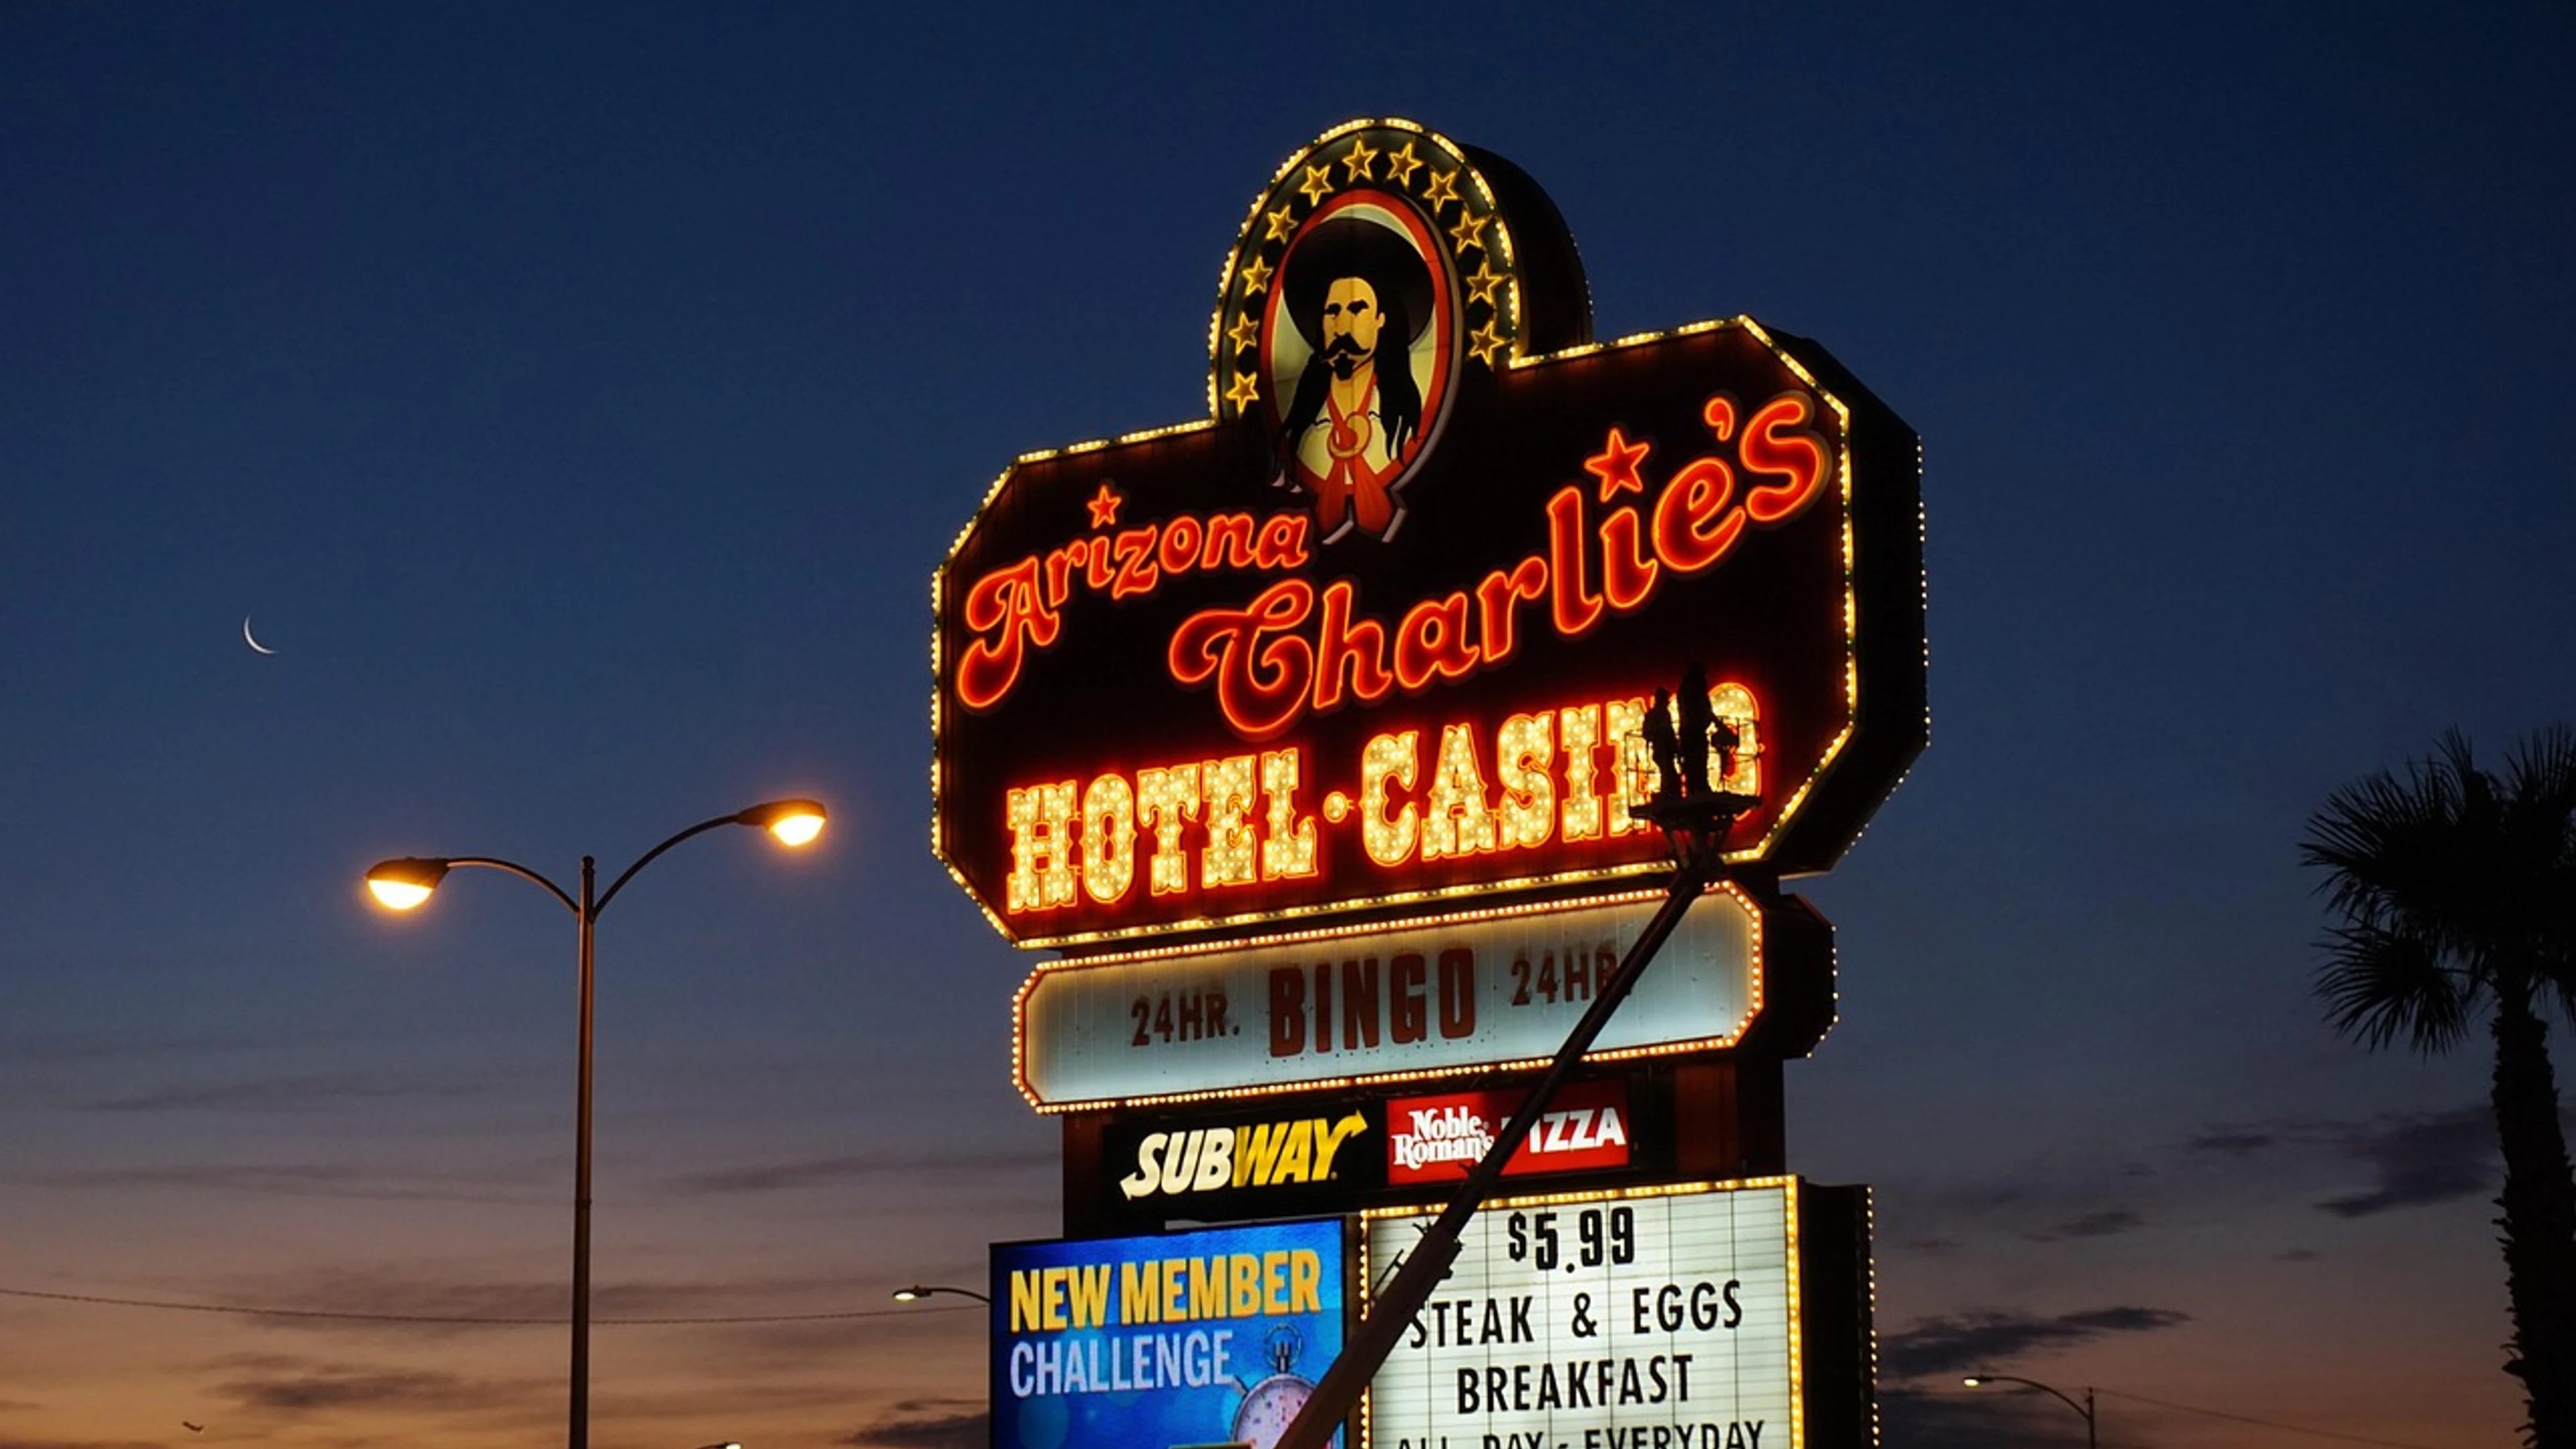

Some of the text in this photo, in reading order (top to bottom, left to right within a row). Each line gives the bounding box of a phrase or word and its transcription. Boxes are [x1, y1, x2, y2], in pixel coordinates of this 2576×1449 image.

[957, 484, 1309, 708] Arizona
[1169, 398, 1821, 732] Charlie's
[1008, 748, 1318, 913] HOTEL
[1269, 948, 1474, 1058] BINGO
[1119, 1109, 1367, 1200] SUBWAY
[1409, 1106, 1482, 1141] Noble
[1501, 1107, 1626, 1153] IZZA
[1509, 1207, 1633, 1273] $5.99
[1010, 1249, 1321, 1333] NEW MEMBER
[1409, 1279, 1742, 1349] STEAK & EGGS
[1010, 1330, 1234, 1399] CHALLENGE
[1458, 1354, 1693, 1413] BREAKFAST
